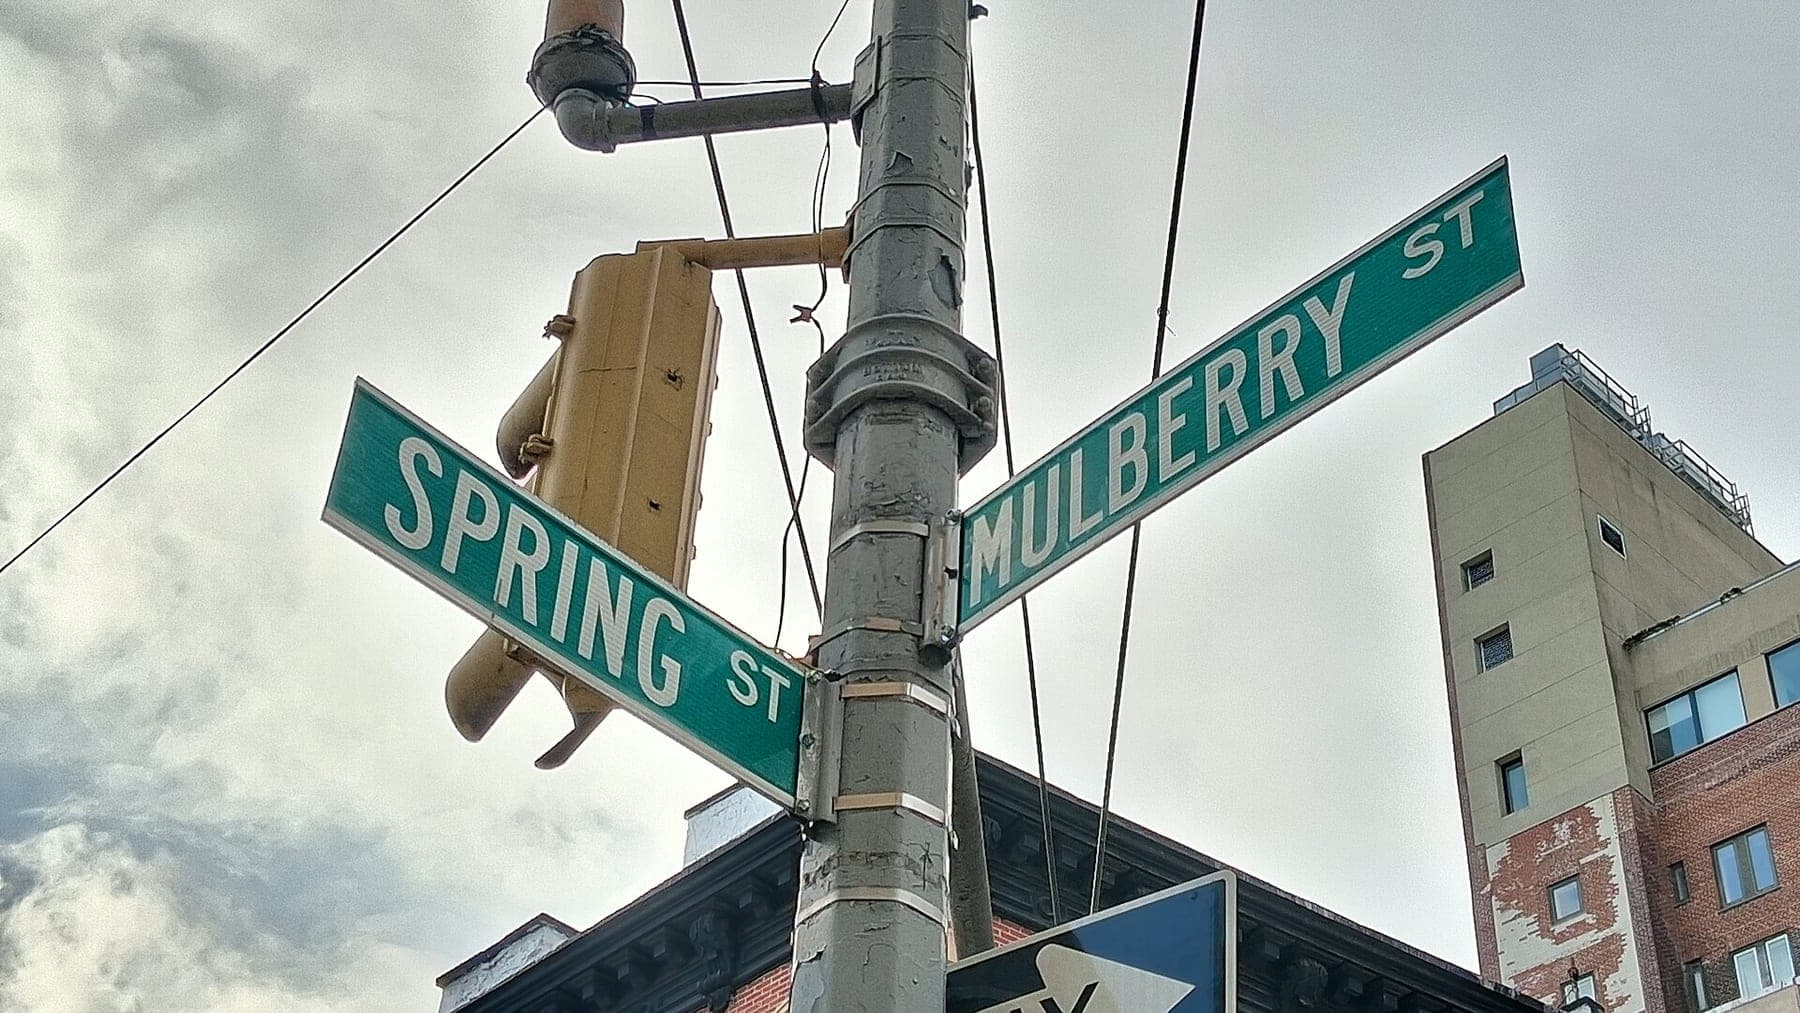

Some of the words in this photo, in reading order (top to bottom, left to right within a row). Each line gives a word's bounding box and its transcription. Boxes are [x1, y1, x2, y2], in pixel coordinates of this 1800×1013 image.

[969, 273, 1355, 607] MULBERRY
[1402, 191, 1485, 280] ST
[384, 437, 685, 707] SPRING
[726, 650, 790, 723] ST
